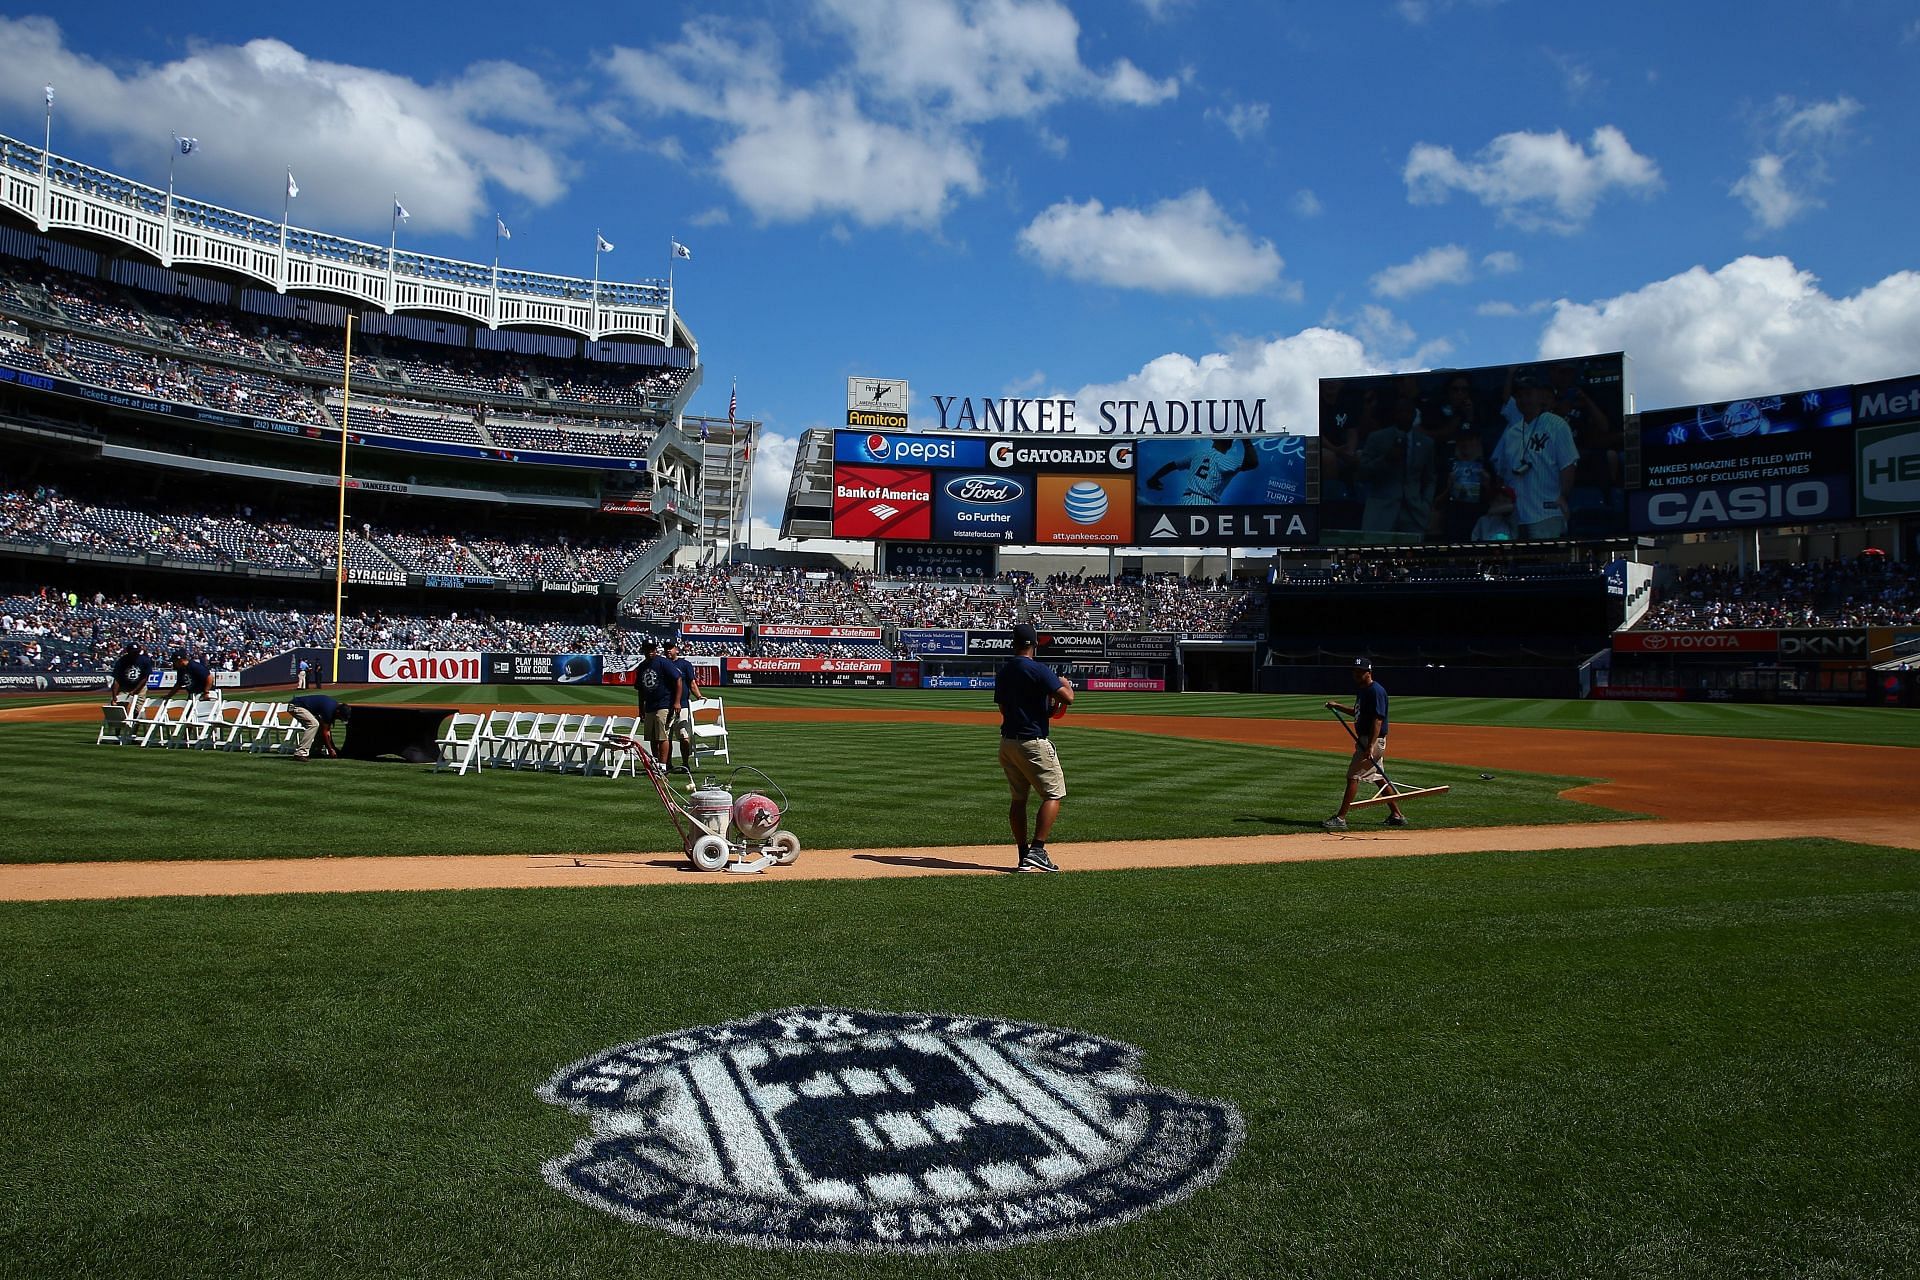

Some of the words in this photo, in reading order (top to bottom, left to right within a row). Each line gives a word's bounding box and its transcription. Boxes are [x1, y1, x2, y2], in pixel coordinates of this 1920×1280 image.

[17, 370, 55, 390] TICKETS
[80, 387, 107, 400] Tickets
[110, 393, 129, 406] start
[131, 398, 140, 407] at
[141, 400, 158, 411] just
[850, 411, 906, 427] Armitron
[931, 396, 1076, 433] YANKEE
[1099, 399, 1266, 434] STADIUM
[253, 419, 269, 430] (212)
[270, 422, 299, 434] YANKEES
[895, 441, 955, 461] pepsi
[1017, 449, 1106, 464] GATORADE
[1649, 462, 1688, 474] YANKEES
[1690, 459, 1737, 471] MAGAZINE
[1739, 457, 1749, 467] IS
[1752, 454, 1783, 466] FILLED
[1786, 451, 1812, 462] WITH
[1649, 477, 1664, 487] ALL
[1666, 474, 1694, 486] KINDS
[1696, 473, 1708, 483] OF
[1711, 470, 1760, 482] EXCLUSIVE
[1762, 464, 1809, 477] FEATURES
[361, 481, 390, 490] YANKEES
[391, 485, 408, 493] CLUB
[960, 479, 1007, 500] Ford
[1268, 479, 1296, 492] MINORS
[838, 486, 867, 499] Bank
[868, 486, 882, 499] of
[882, 488, 930, 502] America
[1266, 490, 1287, 502] TURN
[602, 501, 649, 513] Budweiser
[1648, 481, 1829, 525] CASIO
[957, 512, 972, 522] Go
[974, 512, 1011, 523] Further
[1190, 514, 1307, 536] DELTA
[954, 530, 1000, 539] tristateford.com
[1053, 532, 1119, 542] att.yankees.com
[349, 569, 408, 581] SYRACUSE
[425, 575, 461, 583] EXCLUSIVE
[463, 576, 495, 584] FEATURES
[542, 580, 570, 592] Poland
[572, 581, 599, 595] Spring
[1053, 637, 1102, 645] YOKOHAMA
[1670, 634, 1740, 648] TOYOTA
[1781, 636, 1865, 654] DKNY
[371, 653, 479, 679] Canon
[515, 657, 531, 666] PLAY
[533, 657, 553, 666] HARD.
[516, 666, 531, 674] STAY
[533, 666, 552, 674] COOL.
[53, 675, 105, 684] WEATHERPROOF
[939, 679, 962, 687] Experian
